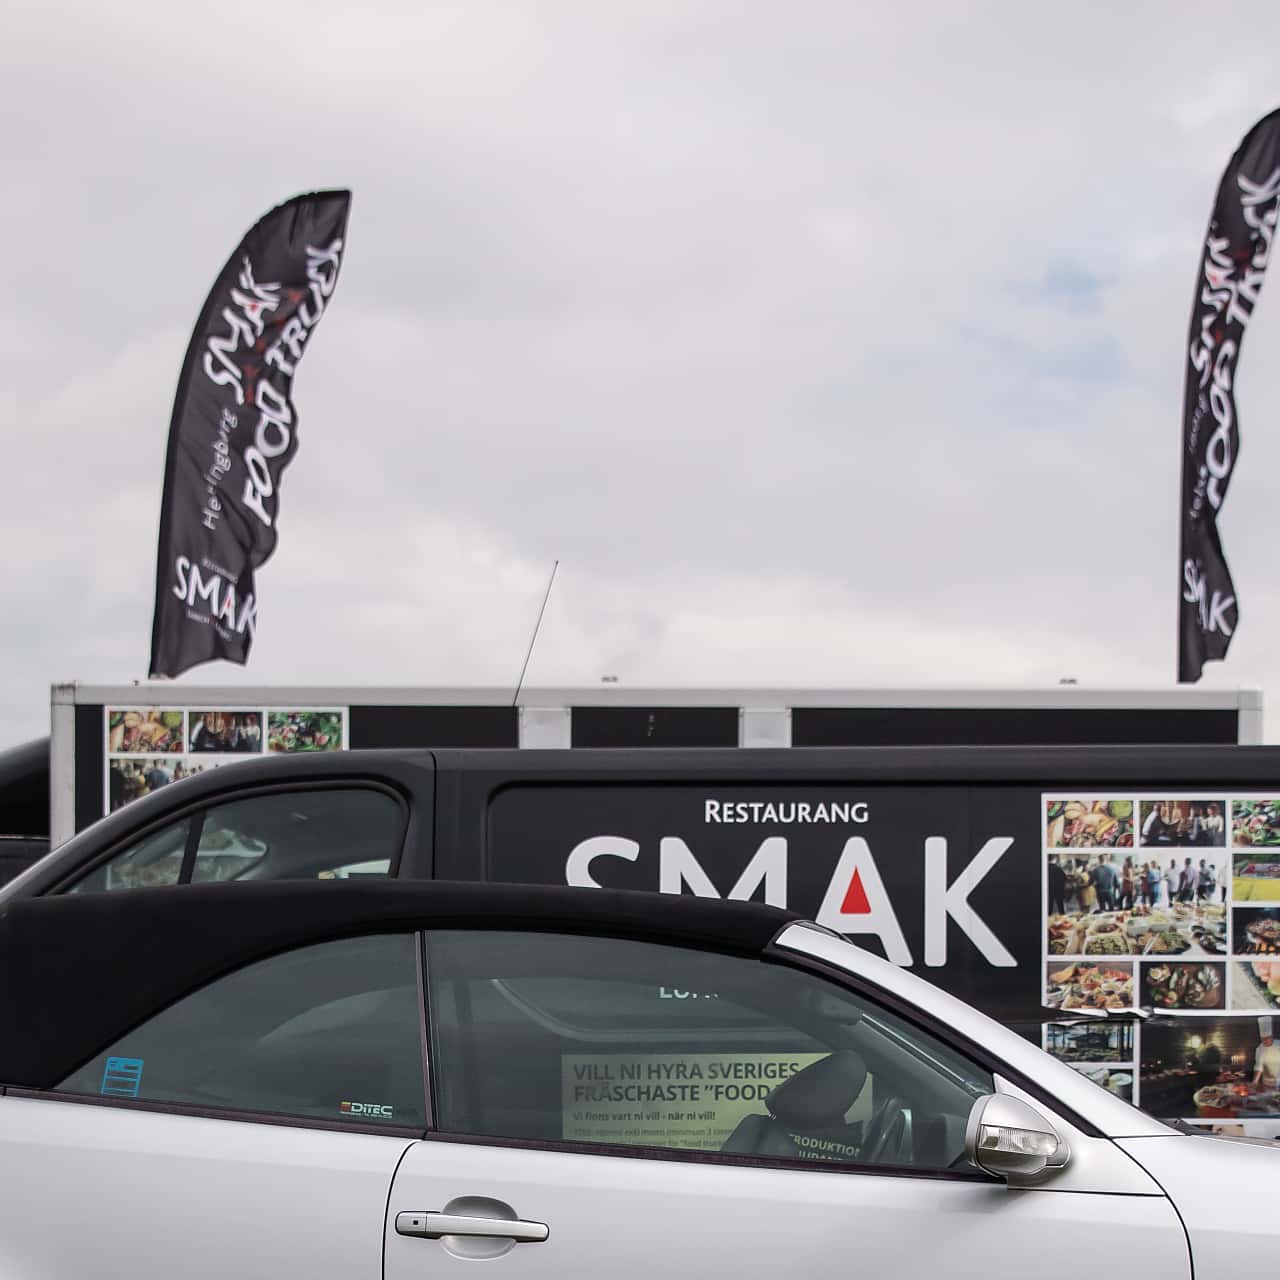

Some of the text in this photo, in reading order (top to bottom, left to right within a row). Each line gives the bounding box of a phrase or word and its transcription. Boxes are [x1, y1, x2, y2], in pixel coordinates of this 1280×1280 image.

[203, 255, 282, 405] SMAK
[265, 238, 344, 377] TRUCK
[573, 1061, 801, 1081] VILL NI HYRA SVERIGES
